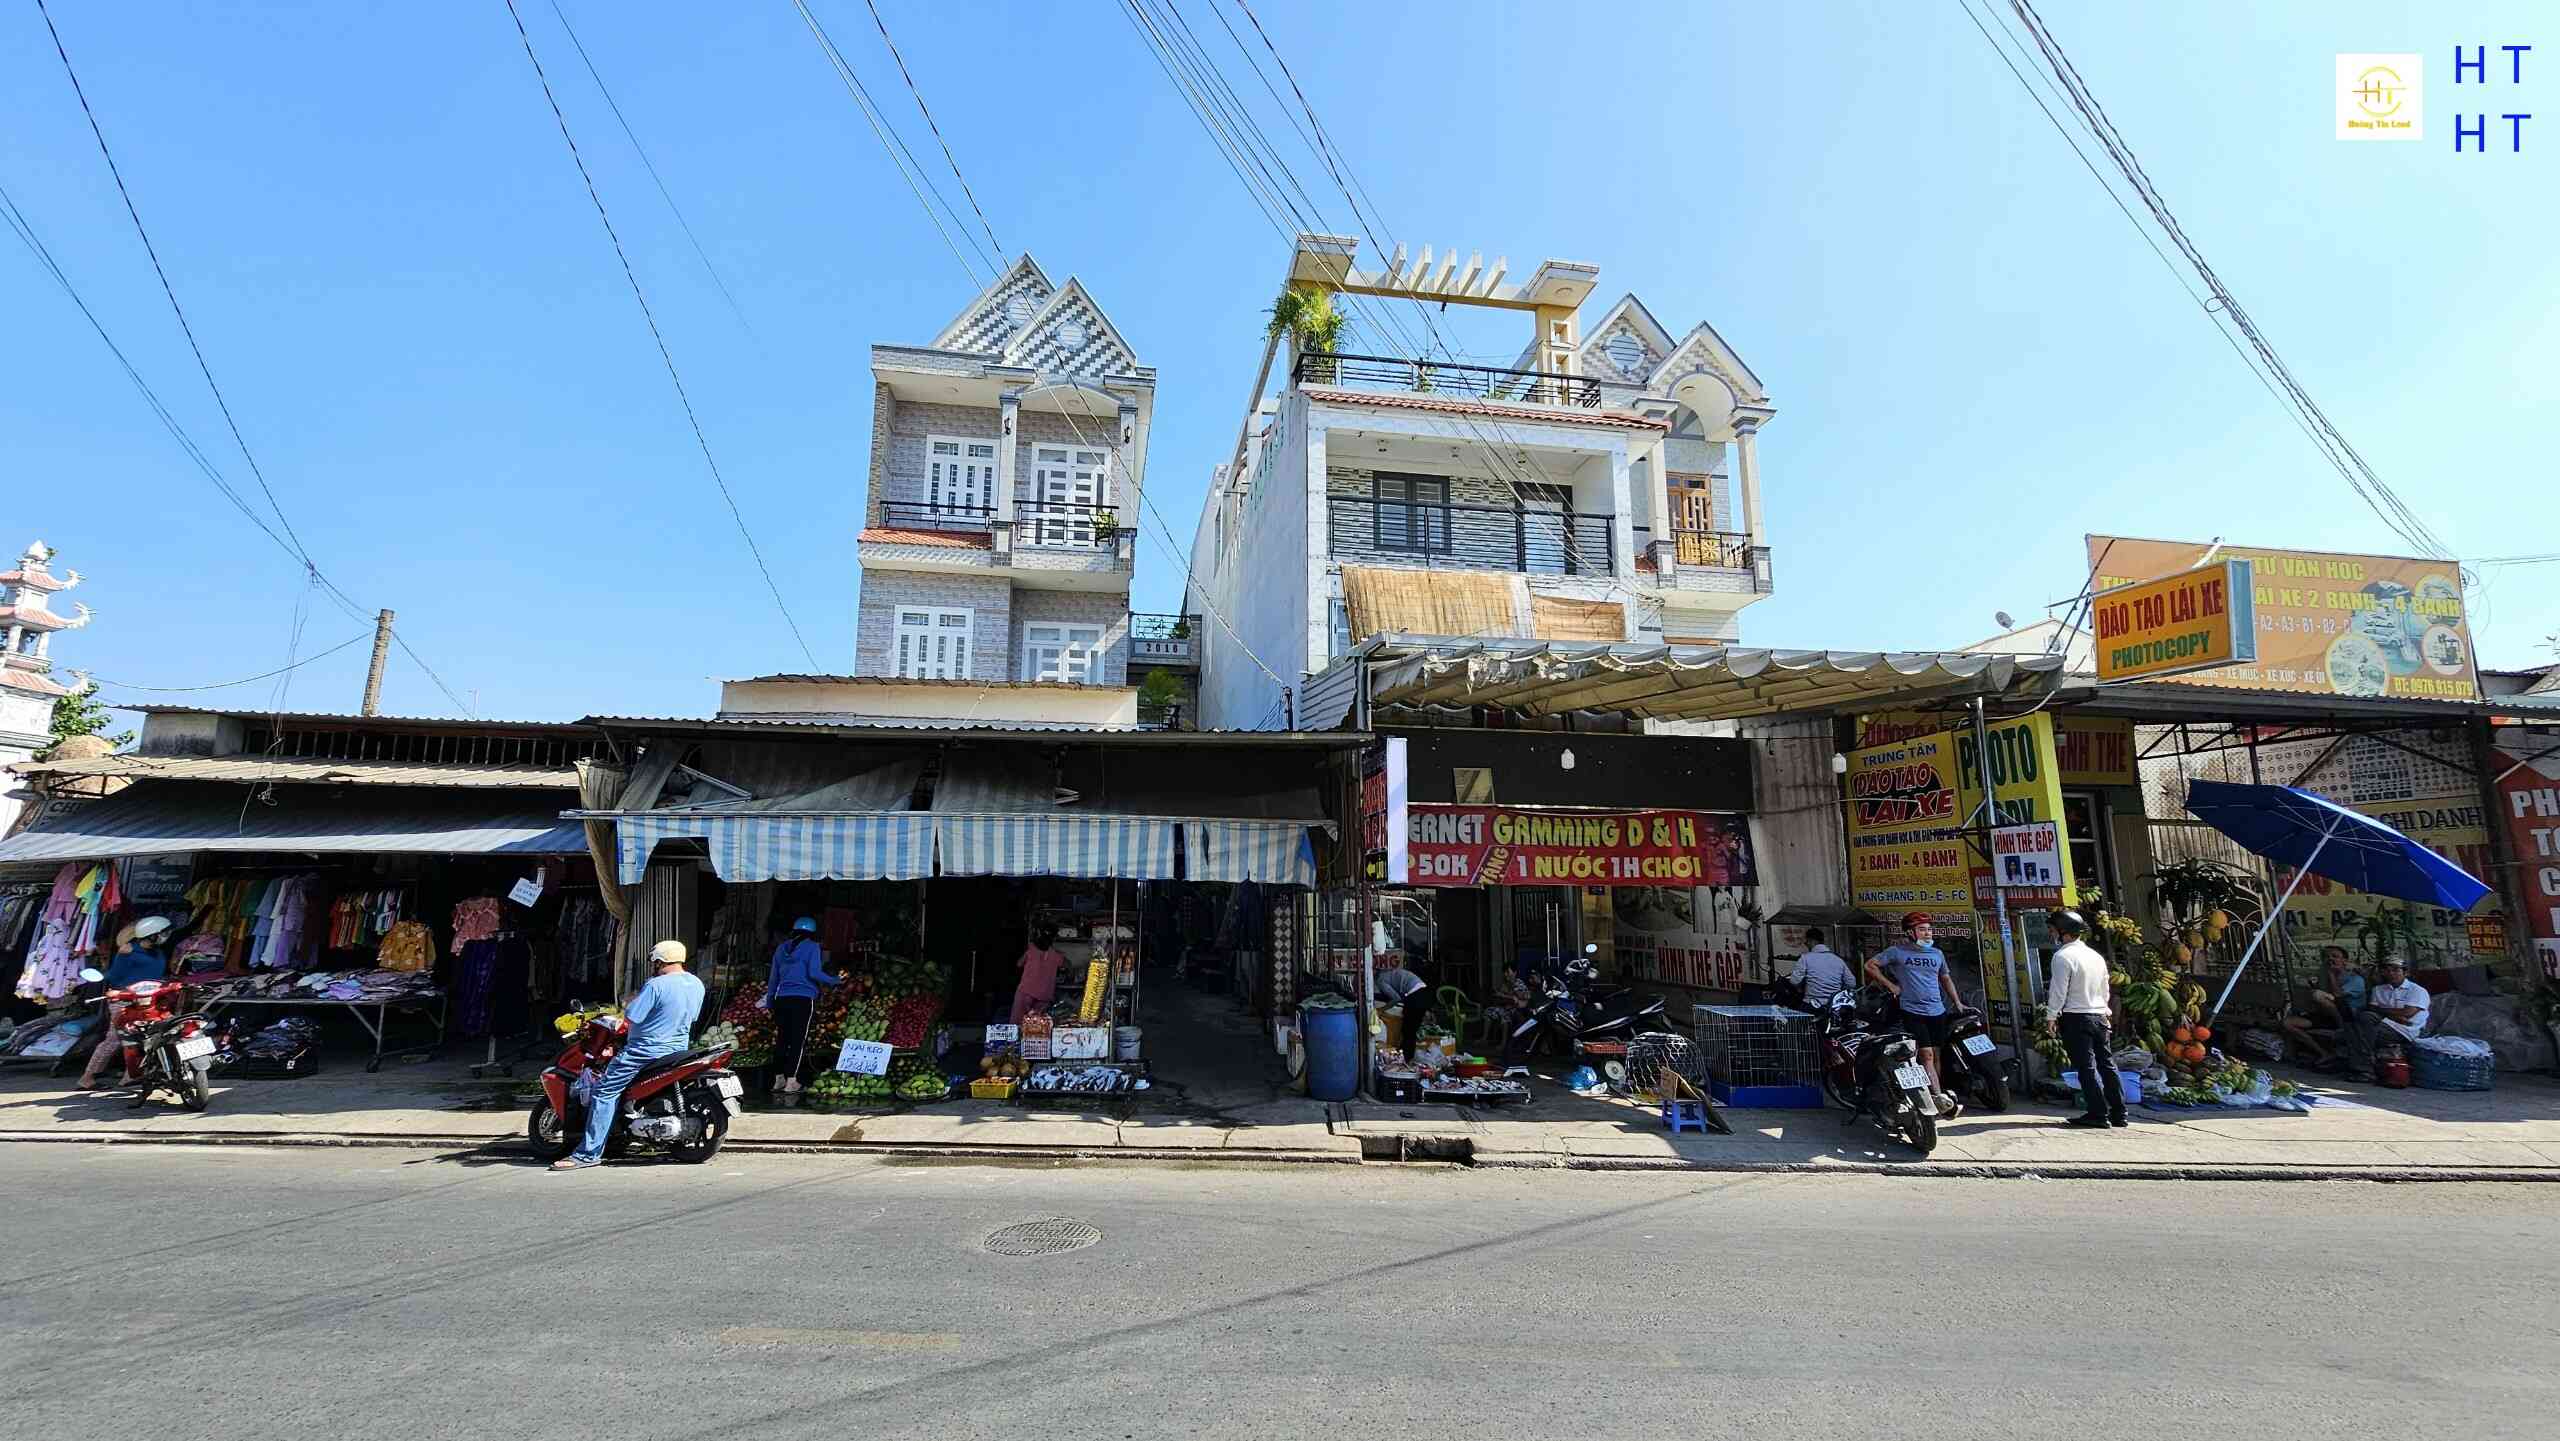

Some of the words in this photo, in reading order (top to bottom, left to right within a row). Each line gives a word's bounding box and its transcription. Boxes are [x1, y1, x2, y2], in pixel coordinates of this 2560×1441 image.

[2133, 593, 2165, 636] TẠO
[2169, 582, 2196, 624] LÁI
[2200, 579, 2224, 617] XE
[2308, 590, 2320, 609] 2
[2112, 629, 2212, 671] PHOTOCOPY
[1863, 749, 1905, 767] TRUNG
[1909, 742, 1937, 760] TÂM
[1912, 788, 1954, 818] XE
[1493, 814, 1620, 848] GAMMING
[1627, 818, 1645, 847] D
[1678, 817, 1696, 847] H
[1418, 853, 1469, 877] 50K
[1517, 855, 1528, 877] 1
[1534, 850, 1606, 879] NƯỚC
[1860, 855, 1867, 871] 2
[1912, 851, 1920, 868] 4
[1920, 890, 1928, 901] D
[1935, 890, 1943, 901] E
[1952, 889, 1967, 901] FC
